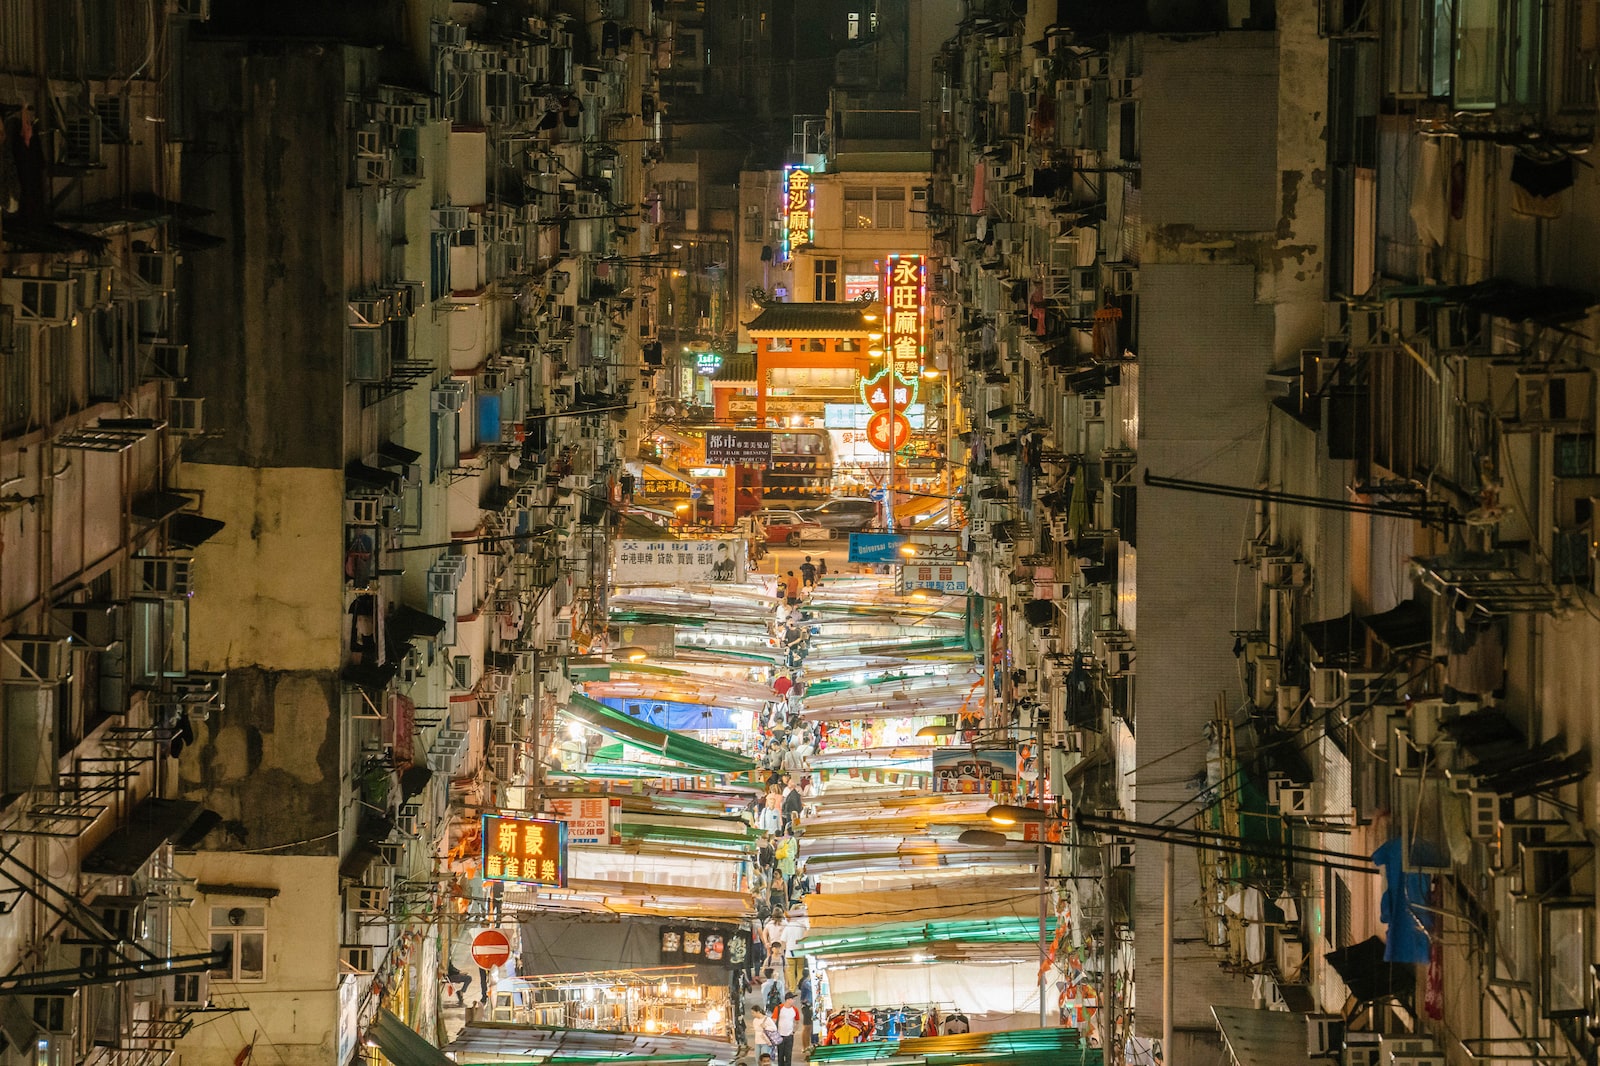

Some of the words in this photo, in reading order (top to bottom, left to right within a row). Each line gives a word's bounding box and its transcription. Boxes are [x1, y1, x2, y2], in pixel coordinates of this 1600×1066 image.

[893, 259, 918, 359] 永旺麻雀
[875, 416, 903, 445] 押
[621, 552, 653, 565] 中港車牌
[657, 552, 674, 565] 貸款
[858, 543, 886, 555] Universal
[550, 800, 603, 819] 幸運
[499, 823, 544, 855] 新豪
[487, 854, 556, 881] 麻雀娛樂
